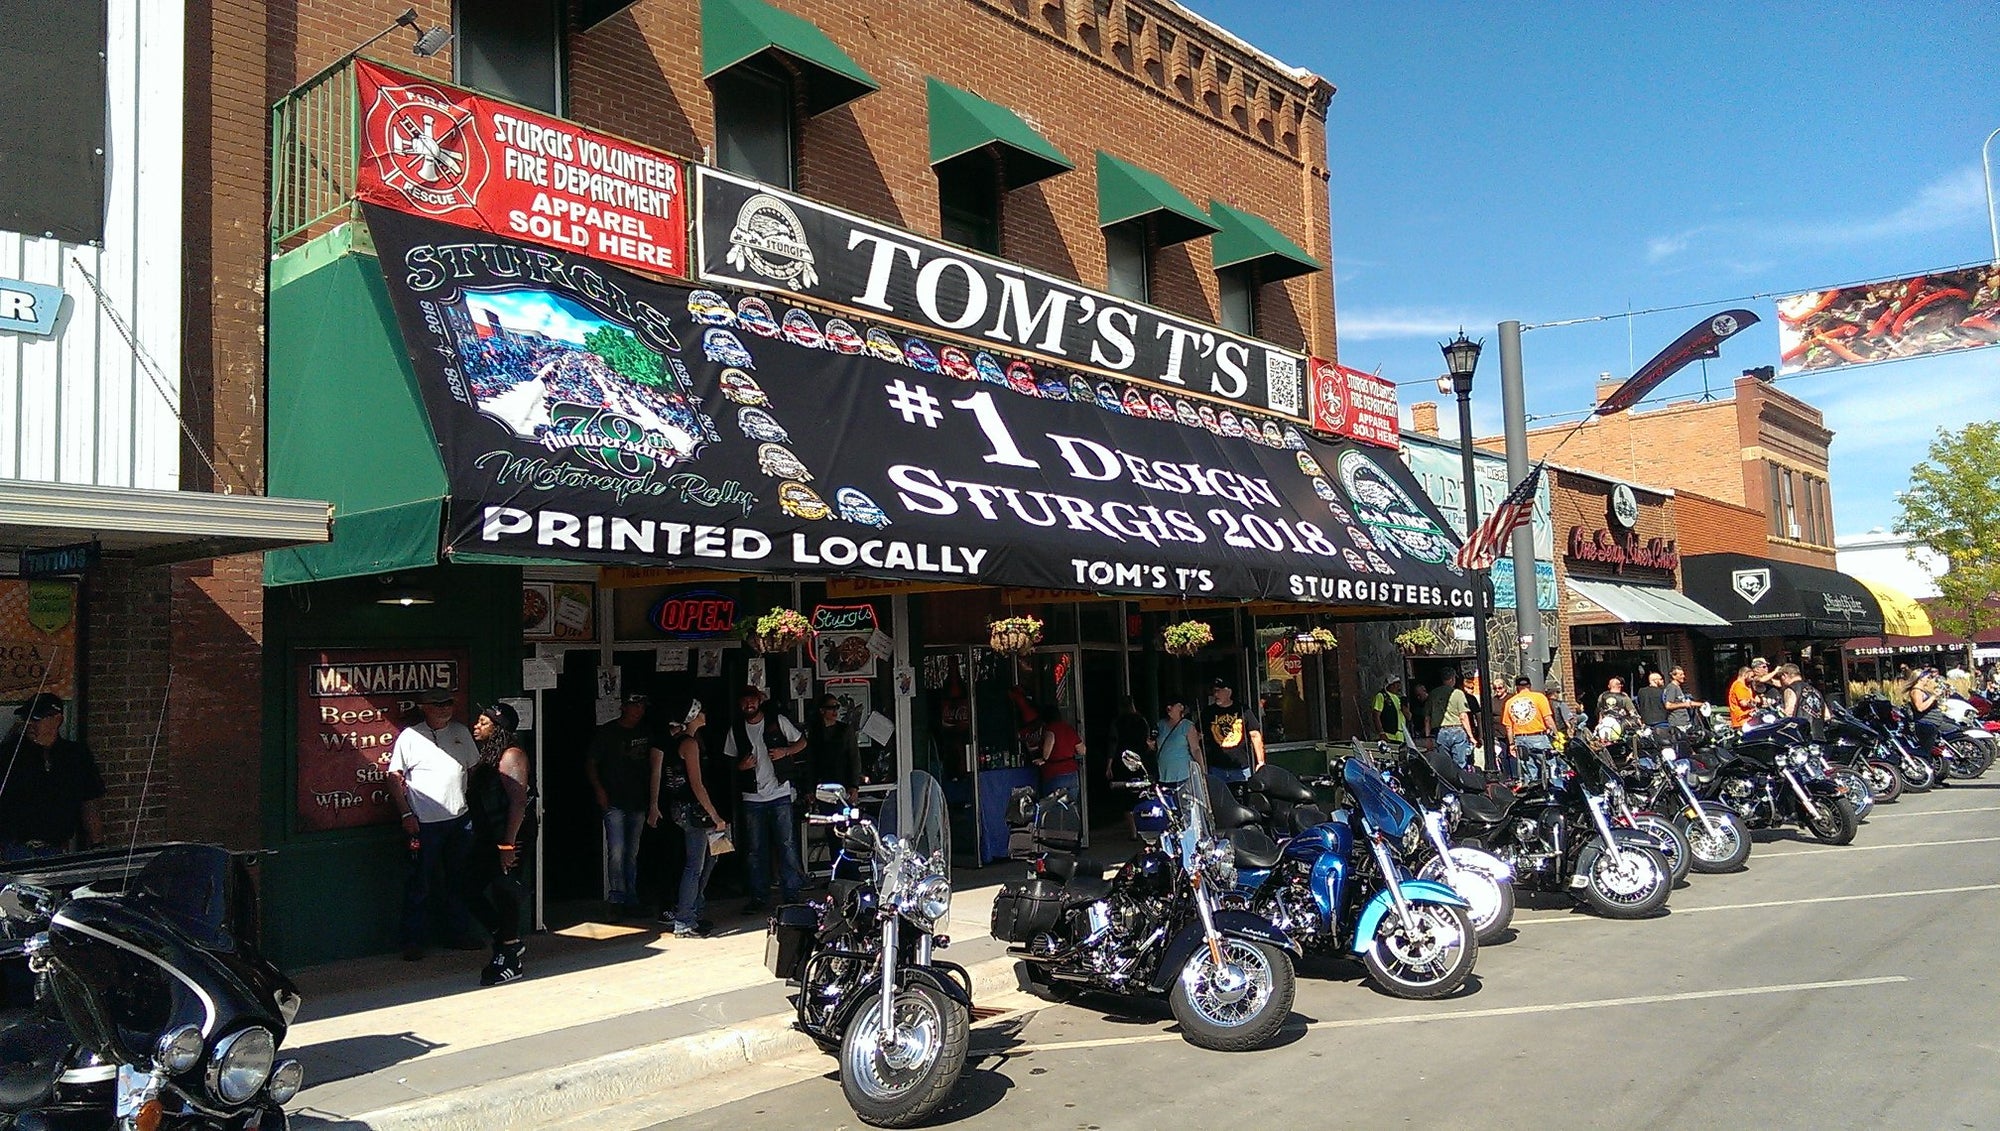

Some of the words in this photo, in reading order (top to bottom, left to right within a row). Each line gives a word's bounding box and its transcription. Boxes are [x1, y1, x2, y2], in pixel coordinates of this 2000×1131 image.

[405, 91, 449, 111] FIRE
[492, 113, 574, 161] STURGIS
[575, 136, 678, 194] VOLUNTEER
[402, 182, 456, 206] RESCUE
[504, 150, 549, 187] FIRE
[553, 163, 671, 220] DEPARTMENT
[531, 192, 653, 241] APPAREL
[509, 210, 590, 248] SOLD
[598, 231, 673, 269] HERE
[765, 239, 806, 258] STURGIS
[404, 242, 682, 352] STURGIS
[847, 227, 1140, 371] TOM'S
[1154, 321, 1250, 400] T'S
[420, 299, 444, 334] 2018
[444, 367, 467, 403] 1938
[670, 357, 694, 388] 1938
[699, 413, 722, 444] 2018
[1346, 373, 1369, 393] STURGIS
[885, 377, 1040, 470] #1
[1358, 413, 1392, 432] APPAREL
[1363, 394, 1398, 418] DEPARTMENT
[539, 430, 677, 468] Anniversary
[1352, 423, 1375, 439] SOLD
[1376, 431, 1398, 445] HERE
[474, 450, 668, 506] Motorcycle
[667, 472, 758, 518] Rally
[1044, 431, 1282, 512] DESIGN
[888, 464, 1208, 548] STURGIS
[1206, 507, 1338, 558] 2018
[482, 506, 772, 560] PRINTED
[792, 533, 988, 576] LOCALLY
[1573, 528, 1597, 560] One
[1597, 529, 1625, 574] Sexy
[1071, 559, 1169, 589] TOM'S
[1175, 567, 1216, 591] T'S
[1289, 574, 1488, 609] STURGISTEES.CO
[661, 600, 734, 631] OPEN
[813, 607, 874, 631] Sturgis
[1854, 646, 1894, 656] STURGIS
[1899, 644, 1931, 653] PHOTO
[1936, 643, 1943, 652] &
[316, 663, 451, 694] MONAHANS
[319, 706, 389, 725] Beer
[320, 731, 394, 750] Wine
[377, 752, 392, 765] &
[310, 787, 363, 817] Wine
